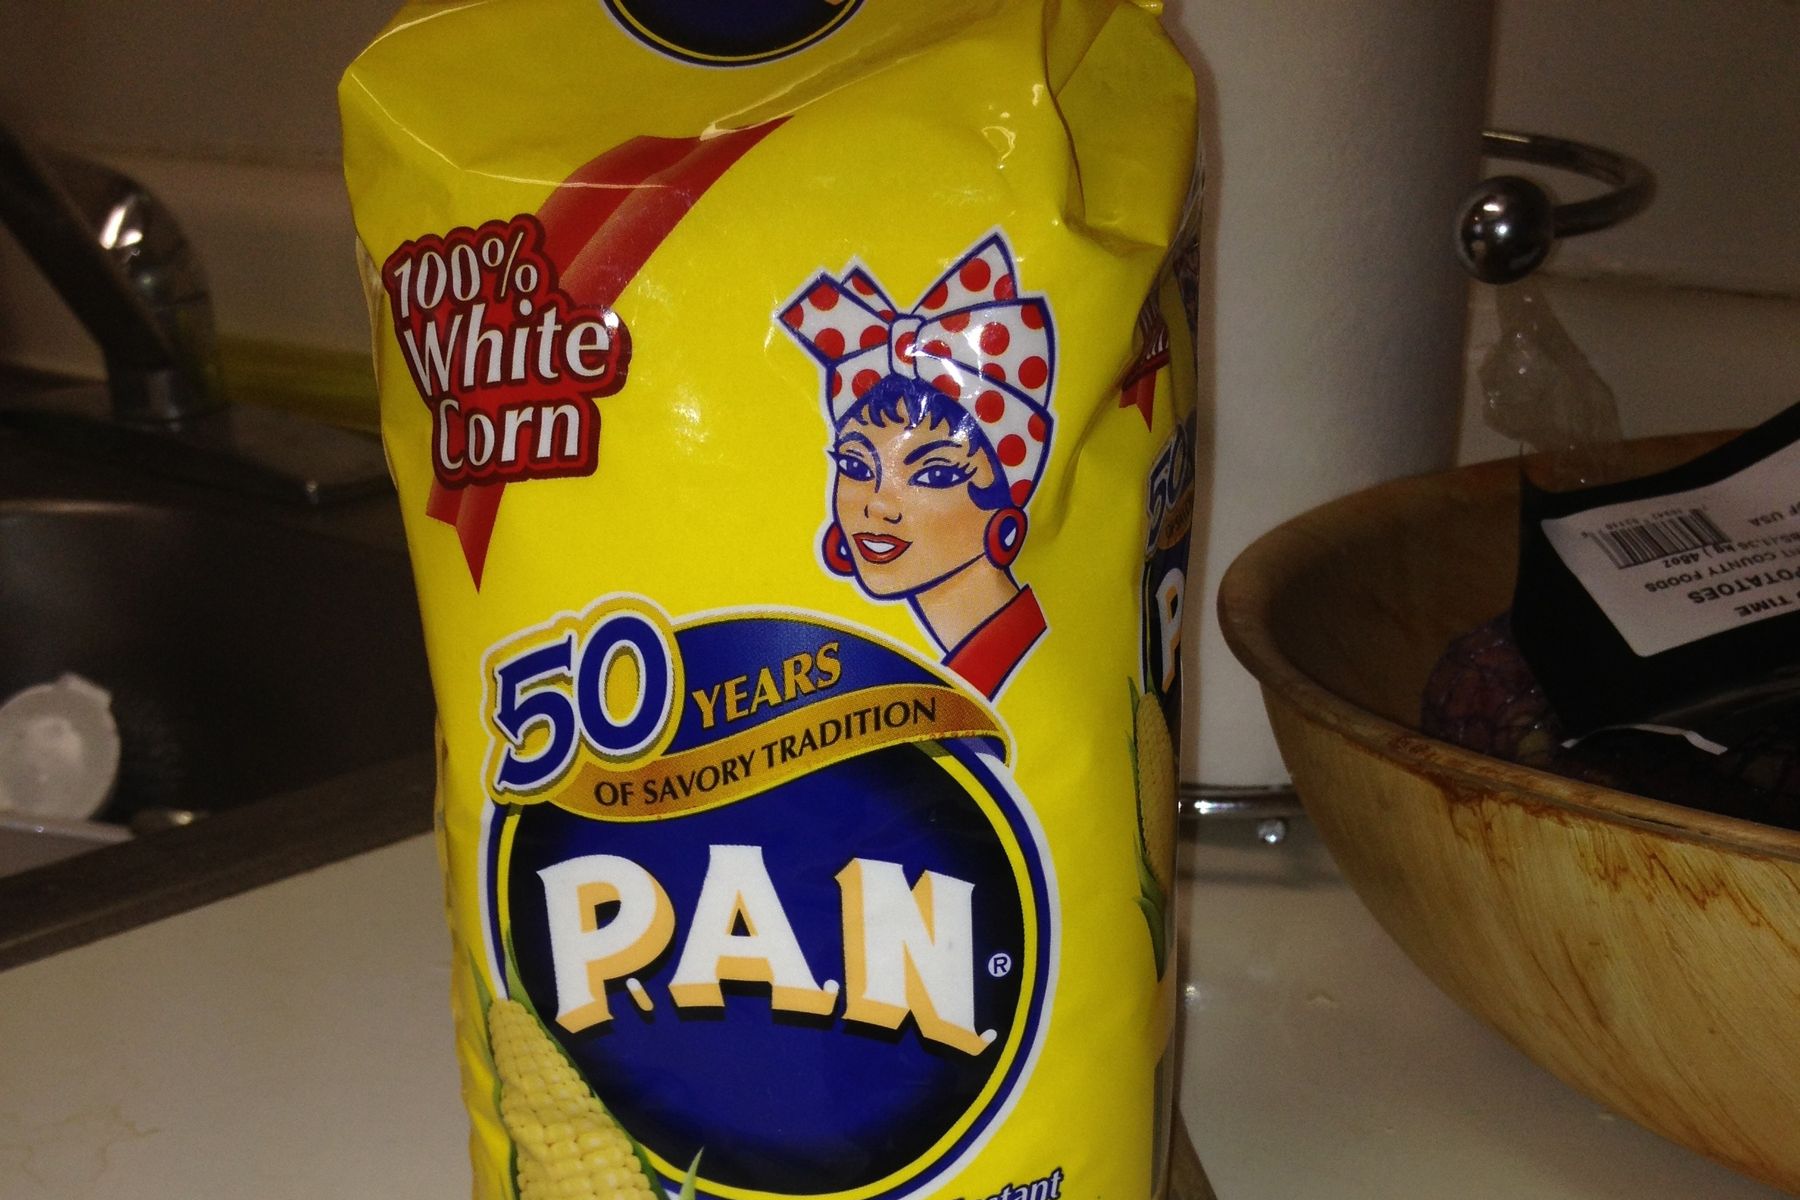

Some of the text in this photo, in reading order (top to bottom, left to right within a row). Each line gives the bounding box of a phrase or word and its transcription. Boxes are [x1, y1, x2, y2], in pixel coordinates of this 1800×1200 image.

[393, 231, 538, 318] 100%
[404, 303, 610, 397] White
[439, 399, 580, 470] Corn
[1643, 570, 1702, 592] FOODS
[1708, 552, 1777, 578] COUNTY
[1734, 595, 1793, 617] TIME
[494, 613, 843, 792] 50 YEARS
[594, 697, 938, 808] OF SAVORY TRADITION
